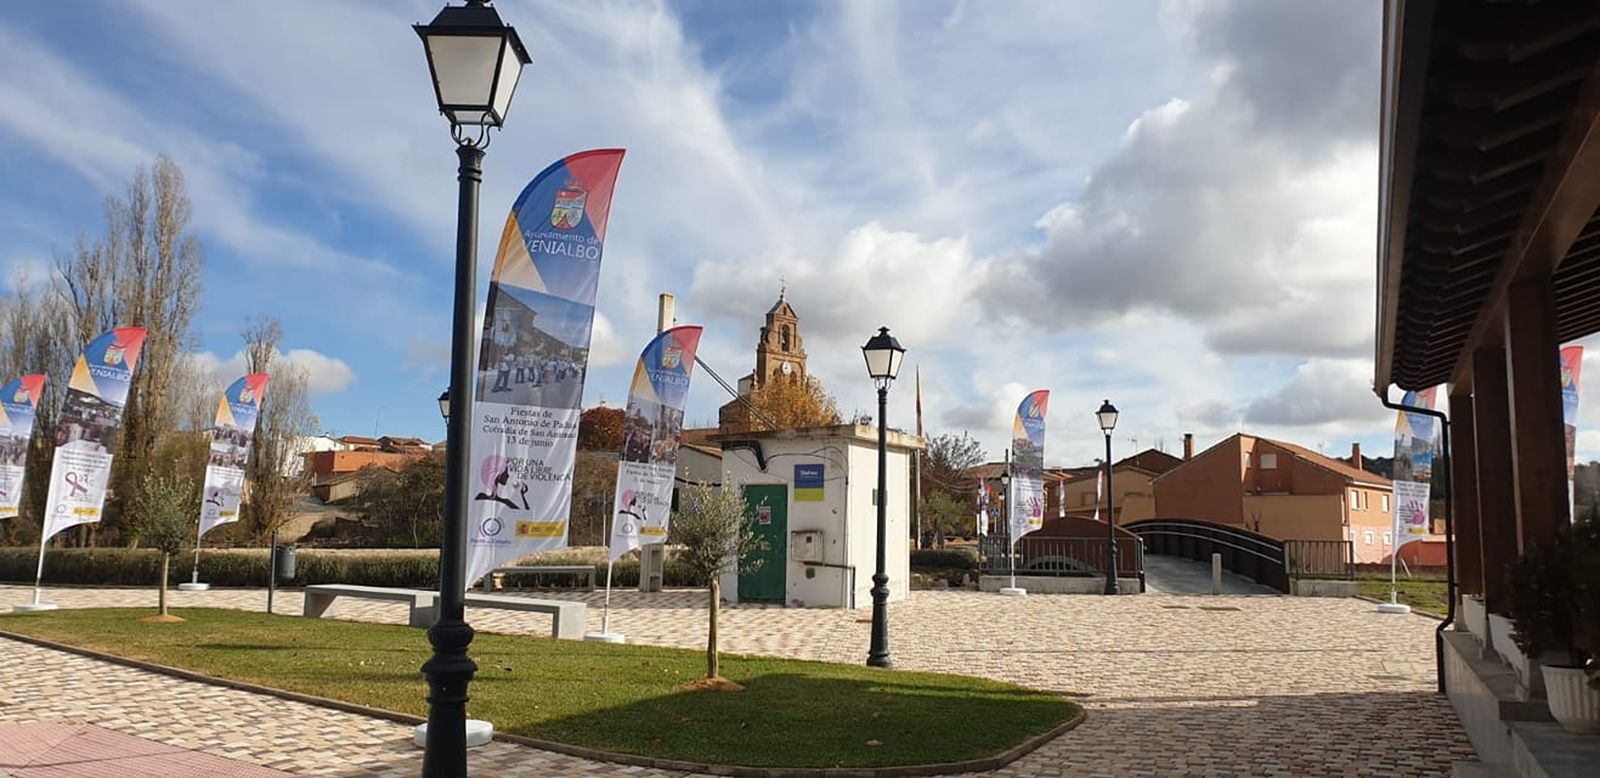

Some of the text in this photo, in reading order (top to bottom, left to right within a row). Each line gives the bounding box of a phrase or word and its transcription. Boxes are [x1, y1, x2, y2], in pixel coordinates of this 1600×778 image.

[522, 239, 599, 260] VENIALBO
[510, 407, 553, 418] Fiestas de
[483, 414, 500, 424] San
[503, 416, 538, 427] Antonio
[540, 420, 552, 428] de
[518, 428, 528, 436] de
[530, 429, 545, 437] San
[518, 437, 530, 446] de
[530, 440, 554, 448] junio
[506, 457, 545, 467] POR UNA
[509, 464, 529, 473] VIDA
[517, 472, 571, 482] DE VIOLENCA
